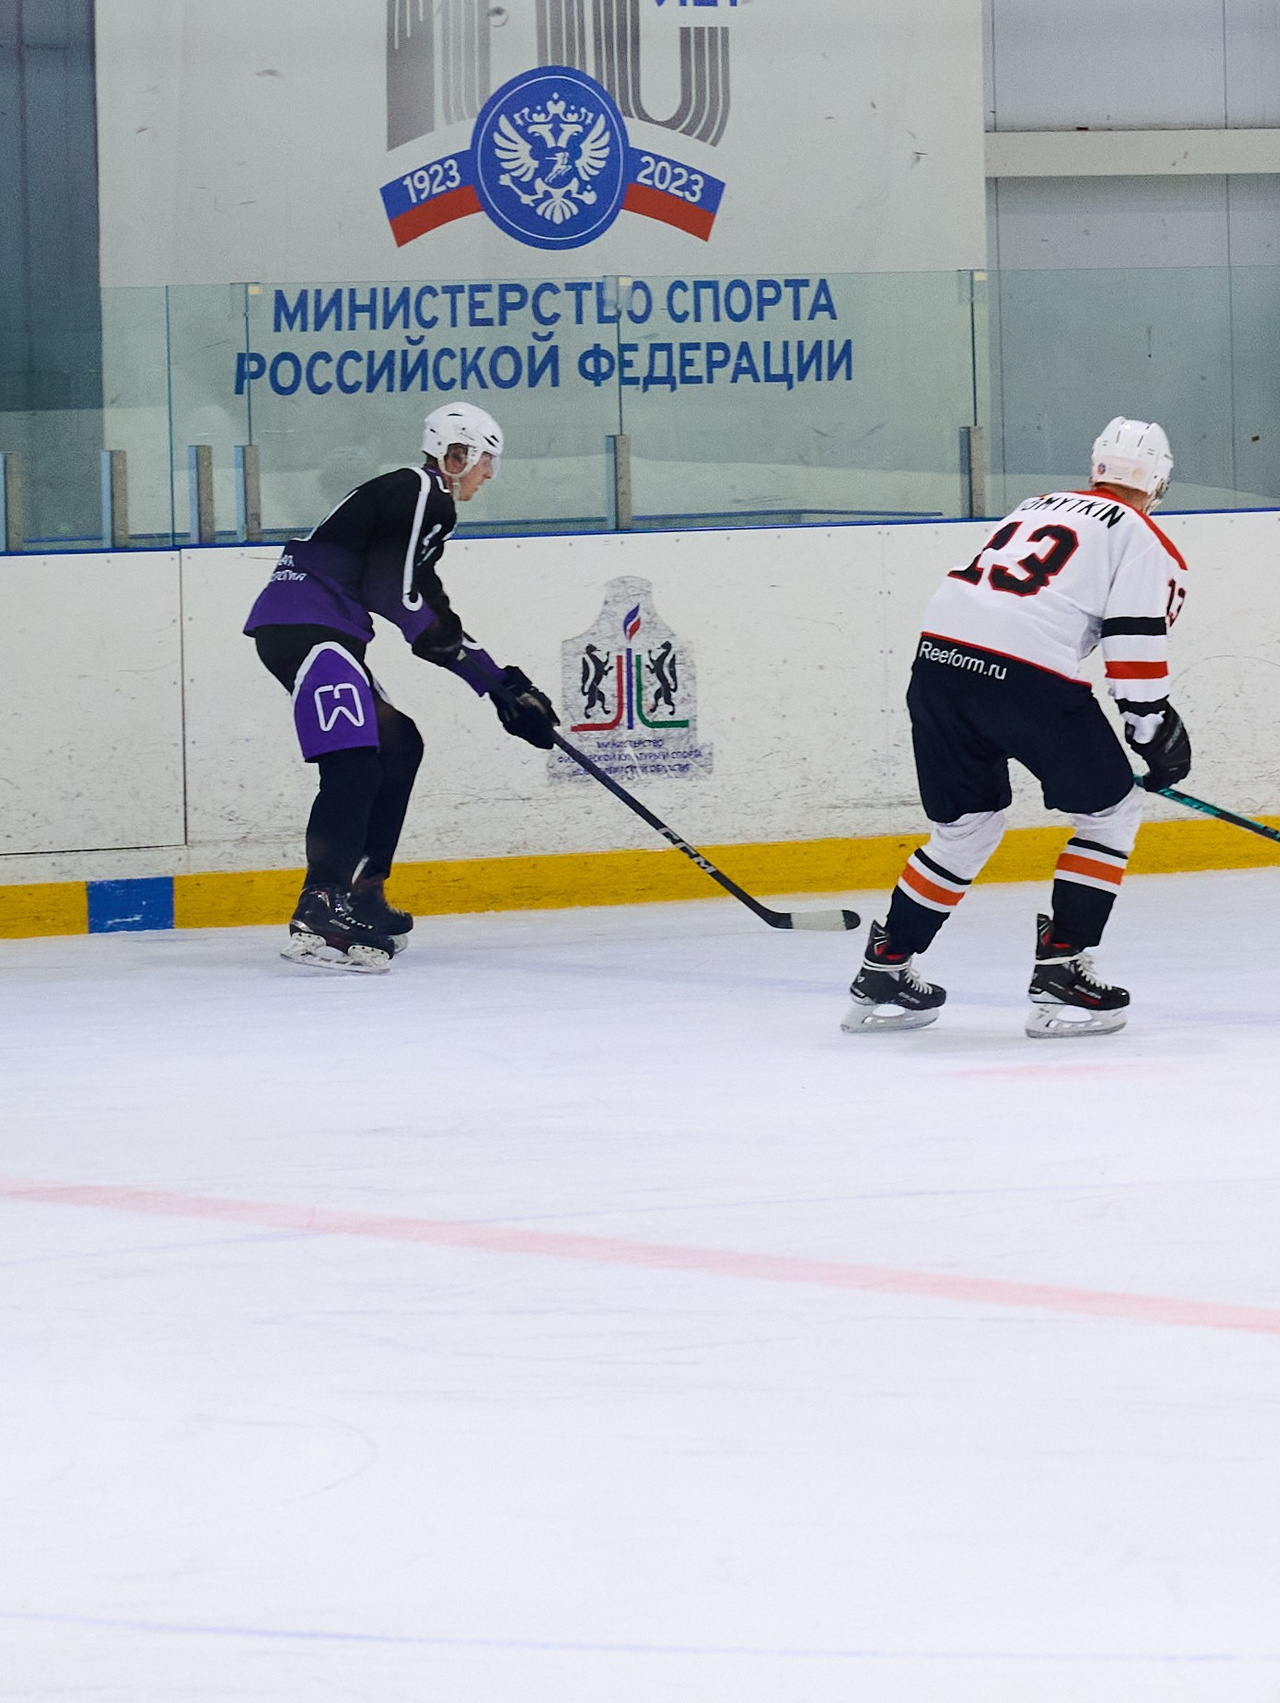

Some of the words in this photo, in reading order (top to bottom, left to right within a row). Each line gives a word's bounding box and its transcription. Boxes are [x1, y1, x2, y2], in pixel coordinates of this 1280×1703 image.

[402, 159, 462, 204] 1923
[636, 156, 705, 204] 2023
[666, 278, 838, 324] СПОРТА
[234, 331, 560, 396] РОССИЙСКОЙ
[577, 338, 852, 393] ФЕДЕРАЦИИ
[947, 521, 1079, 597] 13
[919, 641, 1008, 680] Reeform.ru
